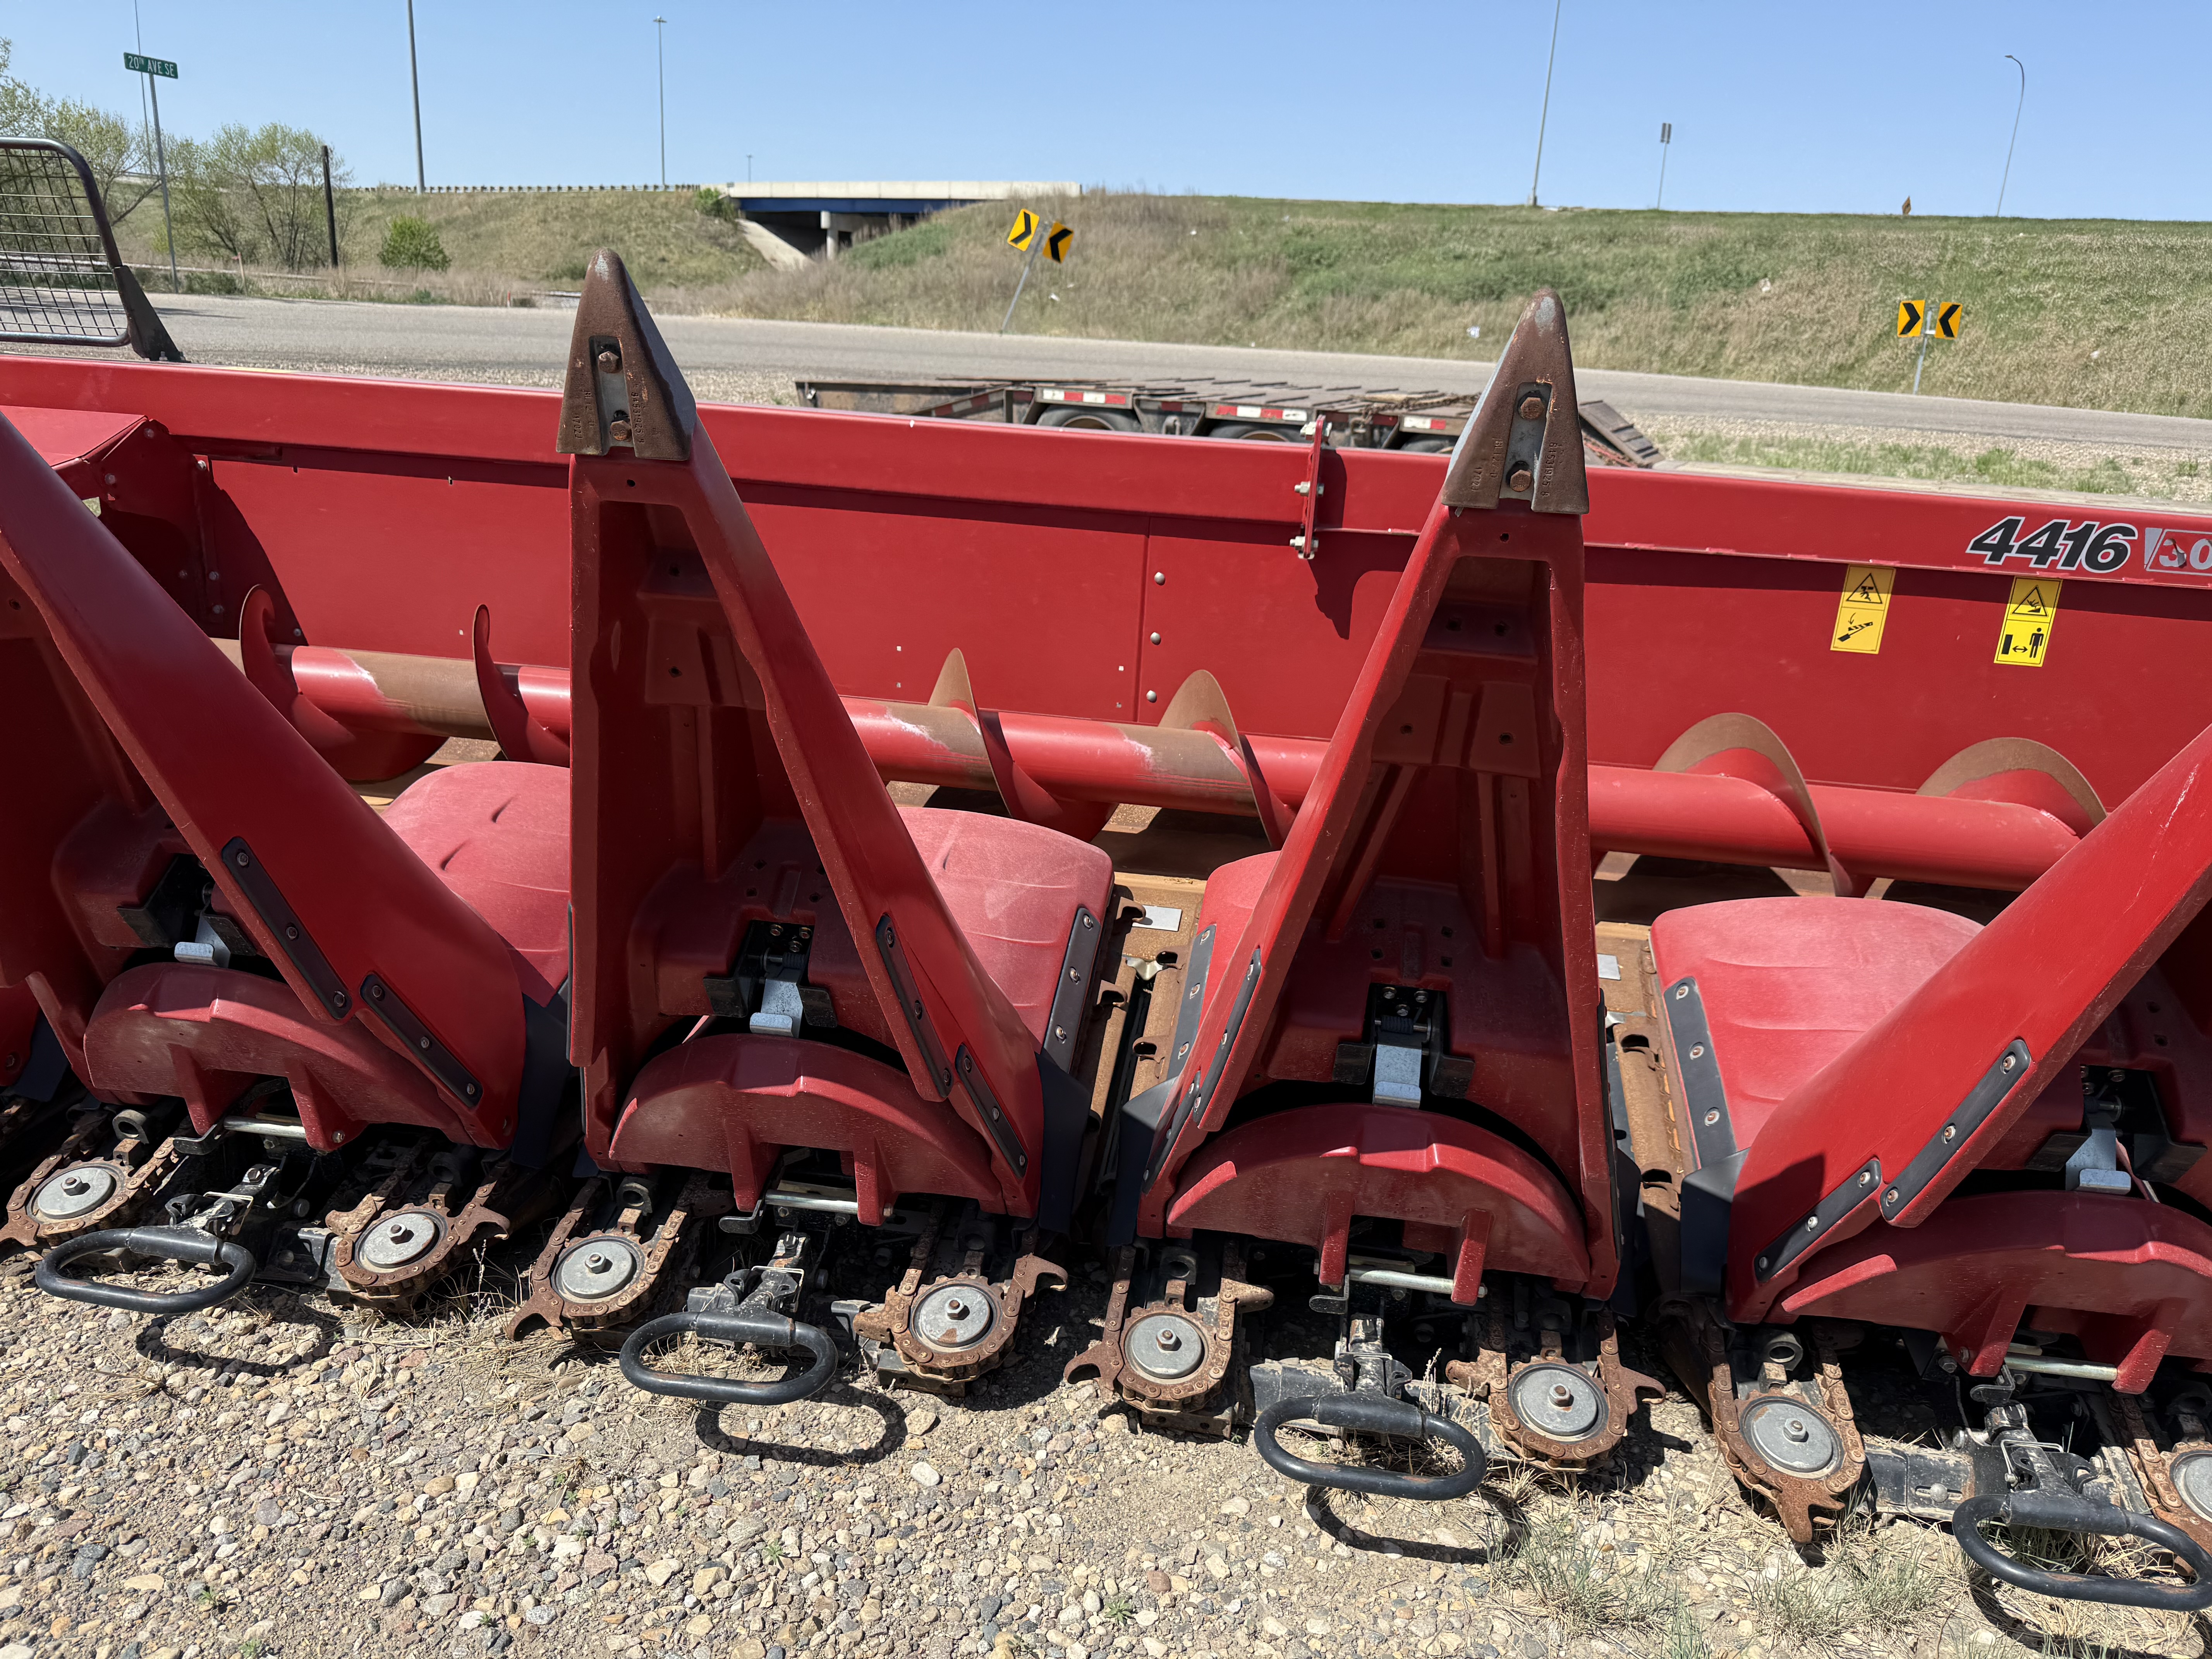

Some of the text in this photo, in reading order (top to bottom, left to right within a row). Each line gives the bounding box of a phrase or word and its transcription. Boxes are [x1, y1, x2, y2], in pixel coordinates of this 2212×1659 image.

[128, 56, 174, 76] 20TH AVE SE
[1965, 516, 2138, 573] 4416
